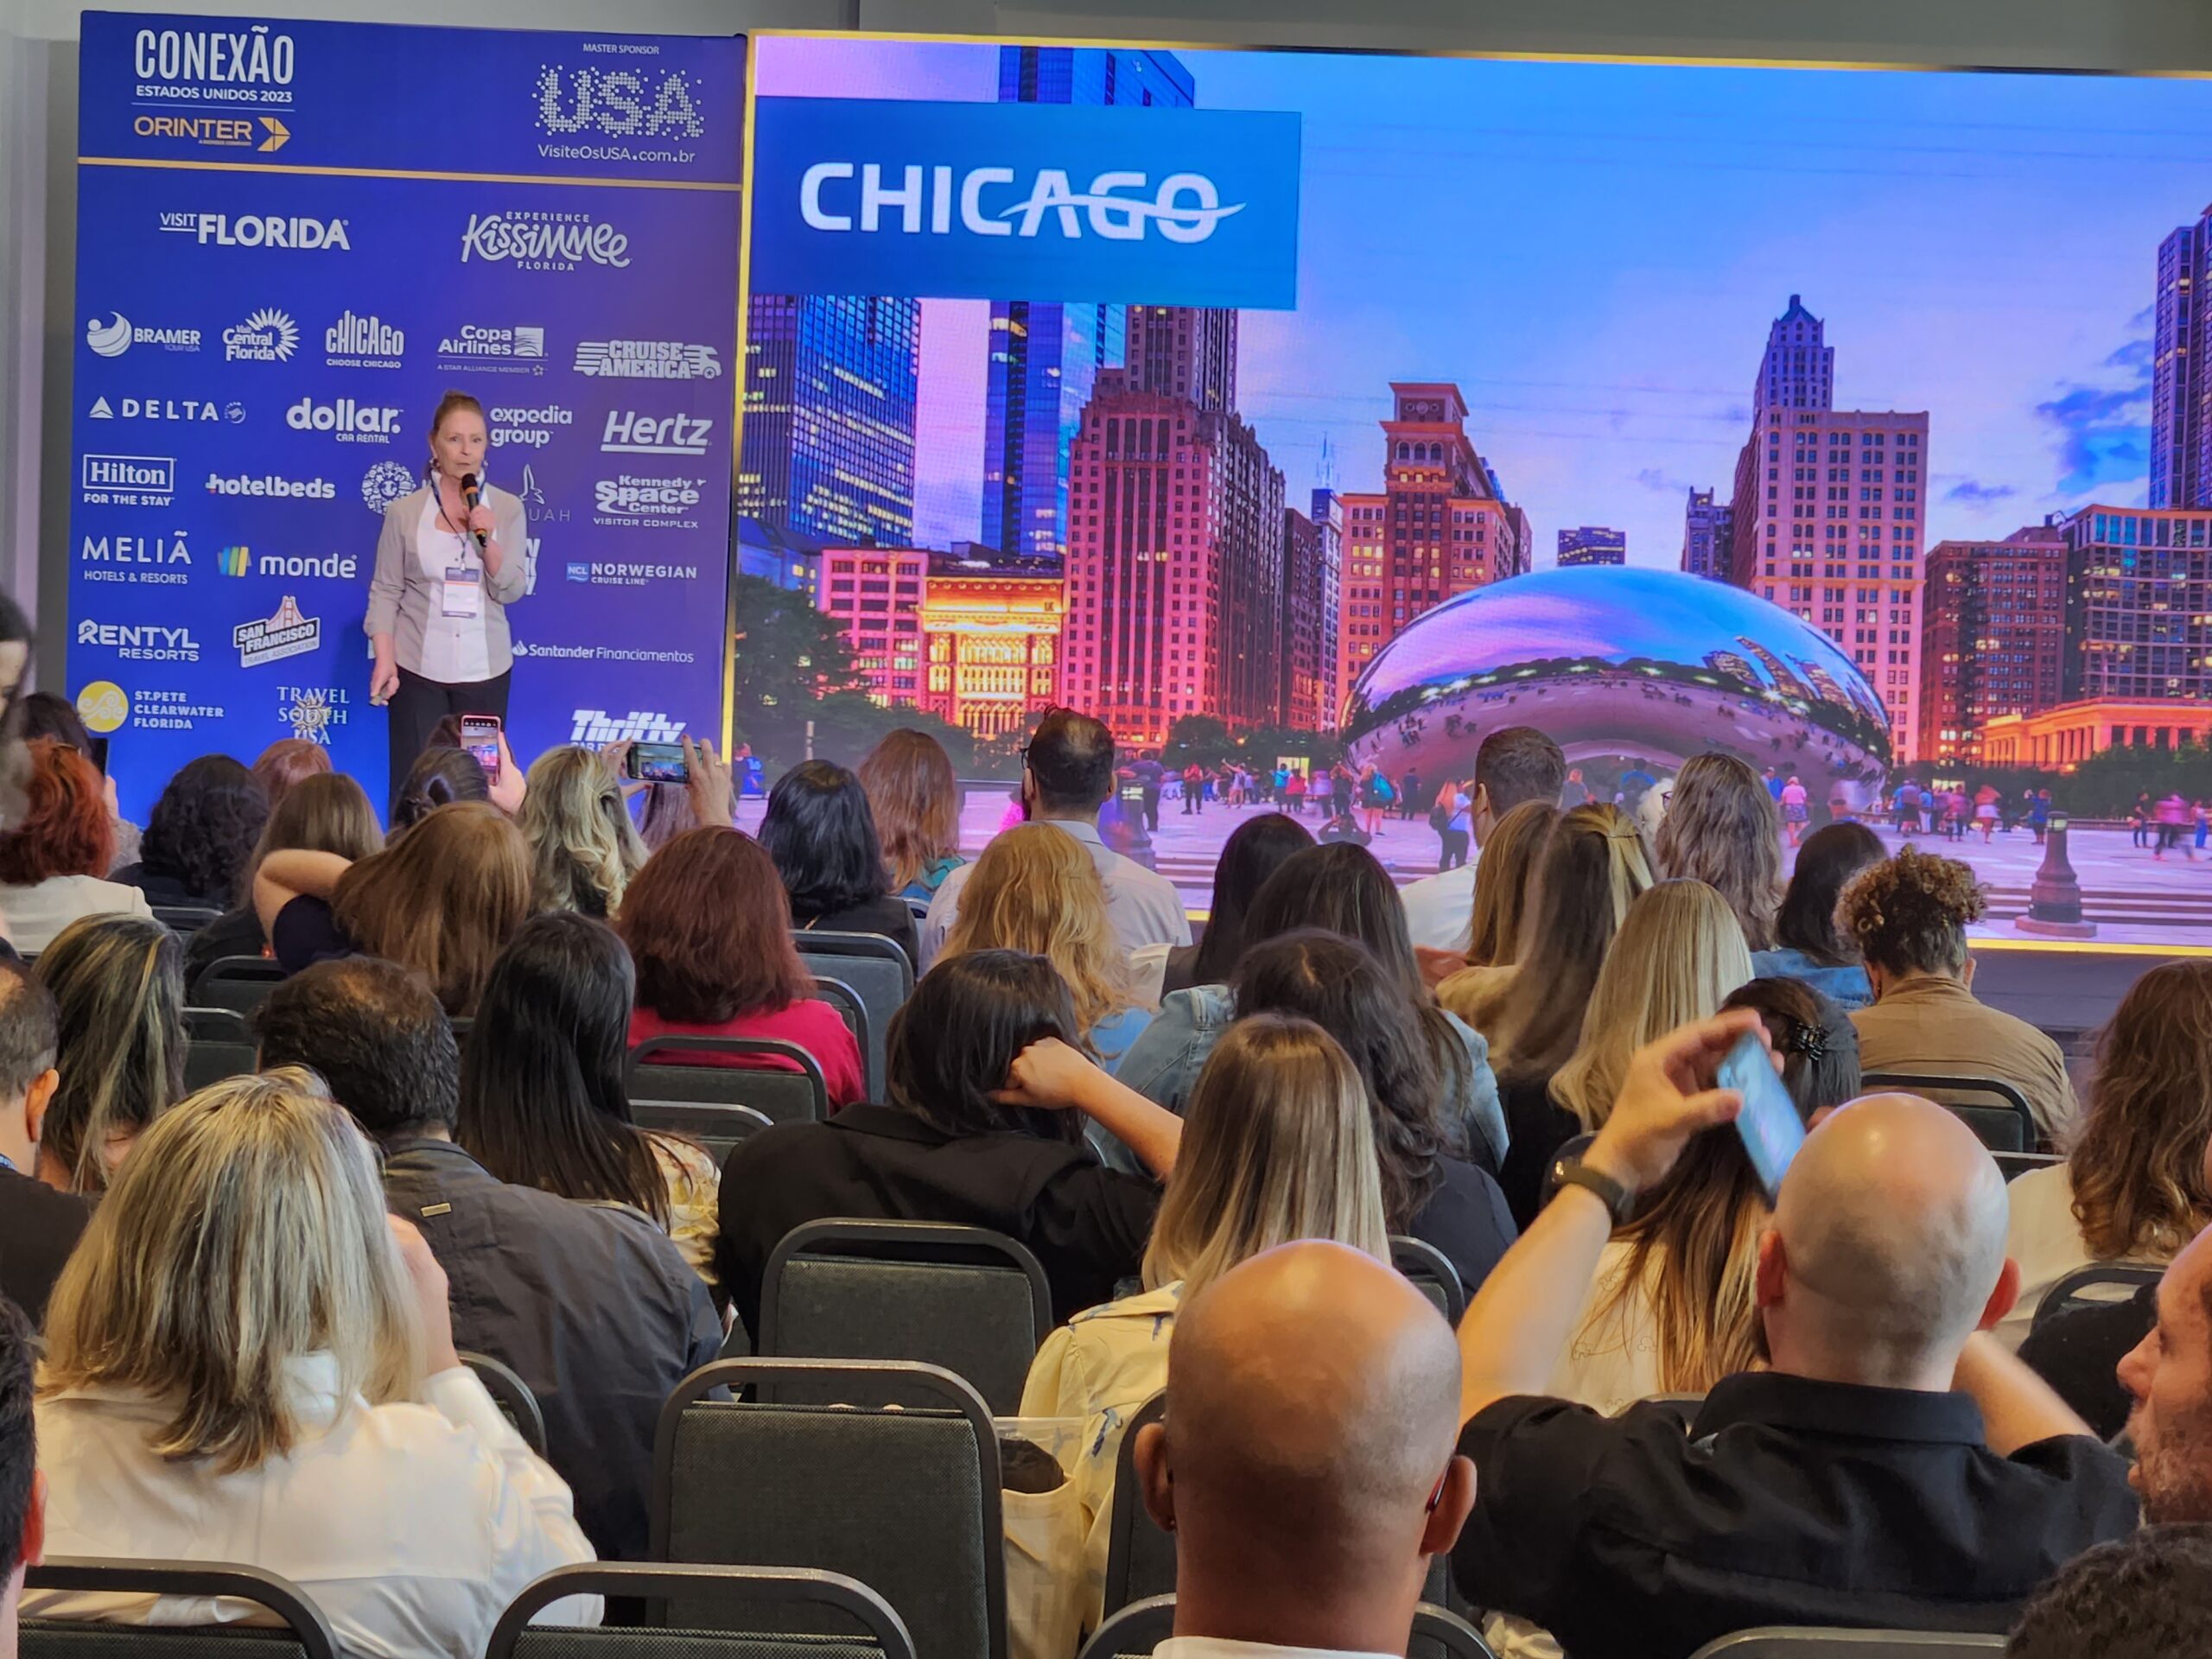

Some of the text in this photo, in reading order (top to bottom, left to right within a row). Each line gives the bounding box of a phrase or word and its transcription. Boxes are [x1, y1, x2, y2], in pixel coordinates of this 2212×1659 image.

[135, 25, 295, 84] CONEXÃO
[583, 43, 659, 54] MASTER SPONSOR
[136, 86, 293, 103] ESTADOS UNIDOS 2023
[536, 66, 703, 139] USA
[134, 116, 252, 140] ORINTER
[537, 143, 696, 162] VisiteOsUSA.com.br
[799, 162, 1220, 244] CHICAGO
[506, 212, 589, 223] EXPERIENCE
[160, 213, 350, 250] VISIT FLORIDA
[518, 261, 574, 271] FLORIDA
[134, 327, 201, 345] BRAMER
[222, 327, 273, 346] Central
[326, 309, 404, 356] CHICAGO
[461, 325, 512, 343] Copa
[226, 345, 276, 362] Florida
[437, 339, 512, 355] Airlines
[608, 340, 683, 361] CRUISE
[326, 358, 401, 369] CHOOSE CHICAGO
[598, 358, 691, 379] AMERICA
[122, 398, 219, 421] DELTA
[490, 404, 572, 429] expedia
[602, 410, 713, 447] Hertz
[335, 433, 390, 443] CAR RENTAL
[491, 428, 550, 448] group
[91, 461, 166, 485] Hilton
[619, 475, 692, 489] Kennedy
[206, 473, 336, 499] hotelbeds
[595, 480, 700, 506] Space
[84, 493, 172, 506] FOR THE STAY
[628, 502, 683, 514] Center
[594, 518, 698, 529] VISITOR COMPLEX
[259, 553, 357, 578] monde
[568, 563, 696, 579] NCL NORWEGIAN
[84, 570, 188, 584] HOTELS & RESORTS
[591, 576, 623, 585] CRUISE
[78, 619, 200, 649] RENTYL
[238, 624, 264, 642] SAN
[245, 623, 315, 653] FRANCISCO
[118, 647, 200, 662] RESORTS
[528, 643, 694, 664] Santander Financiamentos
[276, 686, 350, 704] TRAVEL
[134, 703, 225, 717] CLEARWATER
[278, 707, 347, 725] SOUTH
[134, 717, 194, 729] FLORIDA
[569, 709, 686, 743] Thrifty
